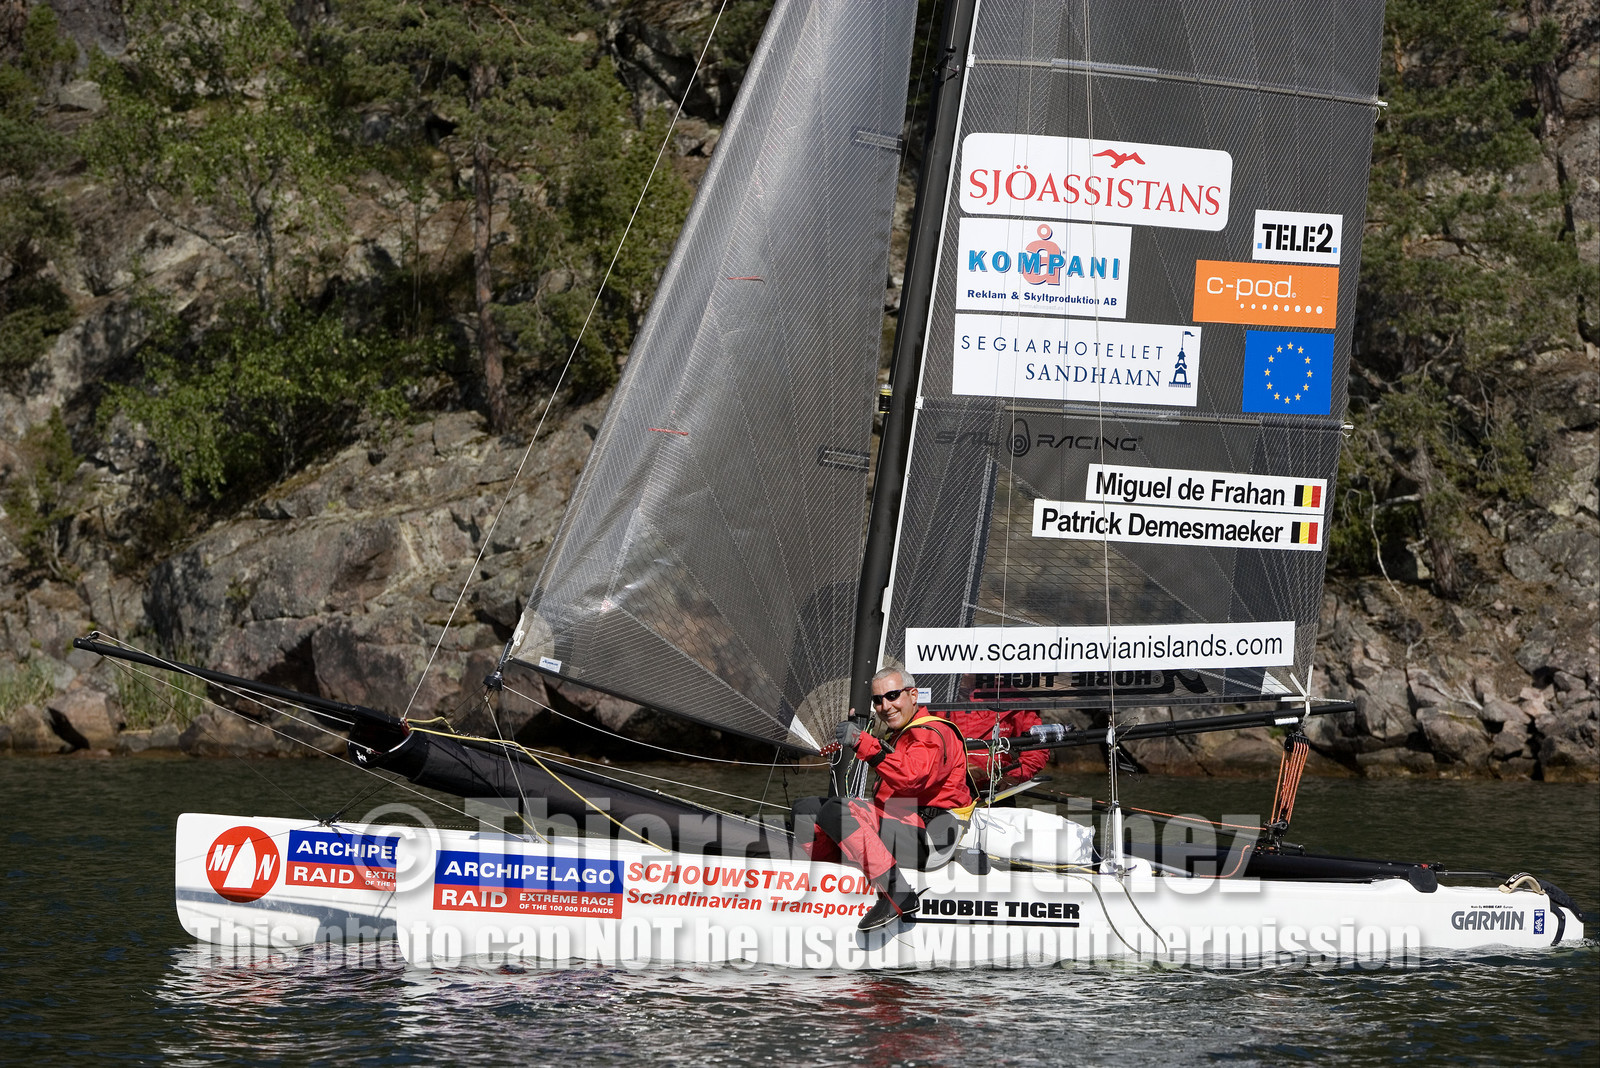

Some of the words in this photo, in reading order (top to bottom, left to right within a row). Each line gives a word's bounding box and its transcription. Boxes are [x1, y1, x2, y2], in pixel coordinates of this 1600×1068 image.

[968, 164, 1222, 216] SJÖASSISTANS
[1261, 222, 1334, 254] TELE2
[967, 249, 1121, 281] KOMPANI
[967, 289, 1007, 301] Reklam
[1010, 290, 1020, 300] &
[1023, 290, 1100, 306] Skyltproduktion
[1103, 296, 1118, 306] AB
[961, 334, 1164, 361] SEGLARHOTELLET
[1025, 362, 1162, 388] SANDHAMN
[1036, 433, 1138, 451] RACING
[1095, 471, 1172, 502] Miguel
[1177, 477, 1205, 501] de
[1211, 479, 1286, 506] Frahan
[1040, 508, 1121, 536] Patrick
[1128, 512, 1284, 544] Demesmaeker
[917, 632, 1283, 664] www.scandinavianislands.com
[293, 865, 355, 885] RAID
[443, 860, 616, 886] ARCHIPELAGO
[626, 862, 876, 896] SCHOUWSTRA.COM
[440, 889, 508, 909] RAID
[519, 892, 578, 905] EXTREME
[581, 896, 614, 906] RACE
[626, 888, 762, 912] Scandinavian
[922, 899, 998, 918] HOBIE
[1004, 901, 1080, 920] TIGER
[1451, 910, 1525, 931] GARMIN
